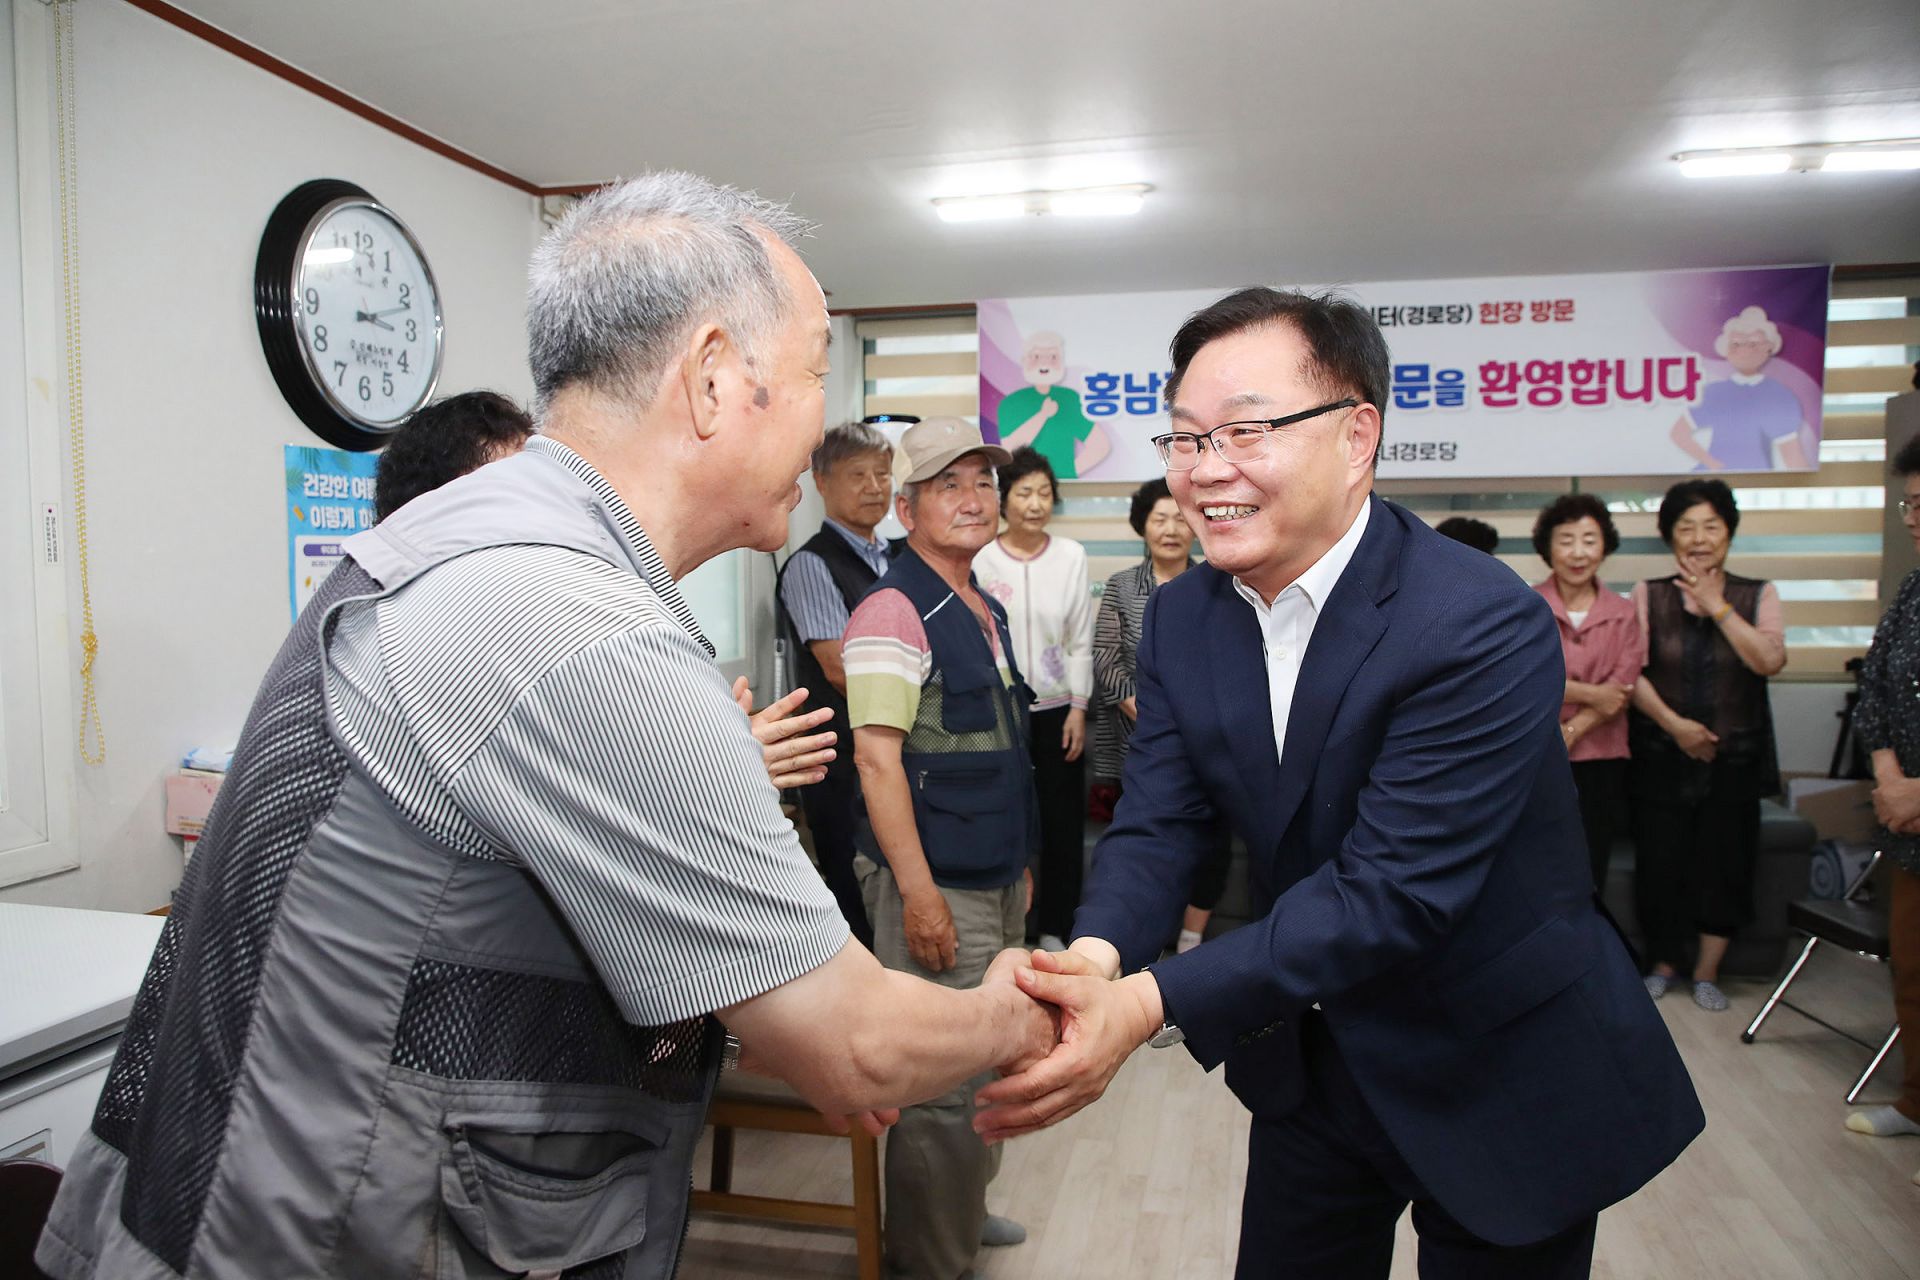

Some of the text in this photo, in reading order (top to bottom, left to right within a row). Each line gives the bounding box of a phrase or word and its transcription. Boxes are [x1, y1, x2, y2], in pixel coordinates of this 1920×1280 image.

[354, 231, 373, 250] 12
[384, 251, 392, 273] 1
[305, 288, 320, 315] 9
[399, 283, 411, 309] 2
[1479, 301, 1524, 325] 현장
[1530, 300, 1575, 322] 방문
[314, 325, 328, 352] 8
[405, 319, 417, 342] 3
[397, 349, 410, 373] 4
[334, 361, 347, 387] 7
[382, 371, 394, 397] 5
[1084, 371, 1171, 416] 홍남
[1479, 357, 1702, 407] 환영합니다
[358, 376, 372, 401] 6
[304, 473, 348, 499] 건강한
[310, 506, 355, 529] 이렇게
